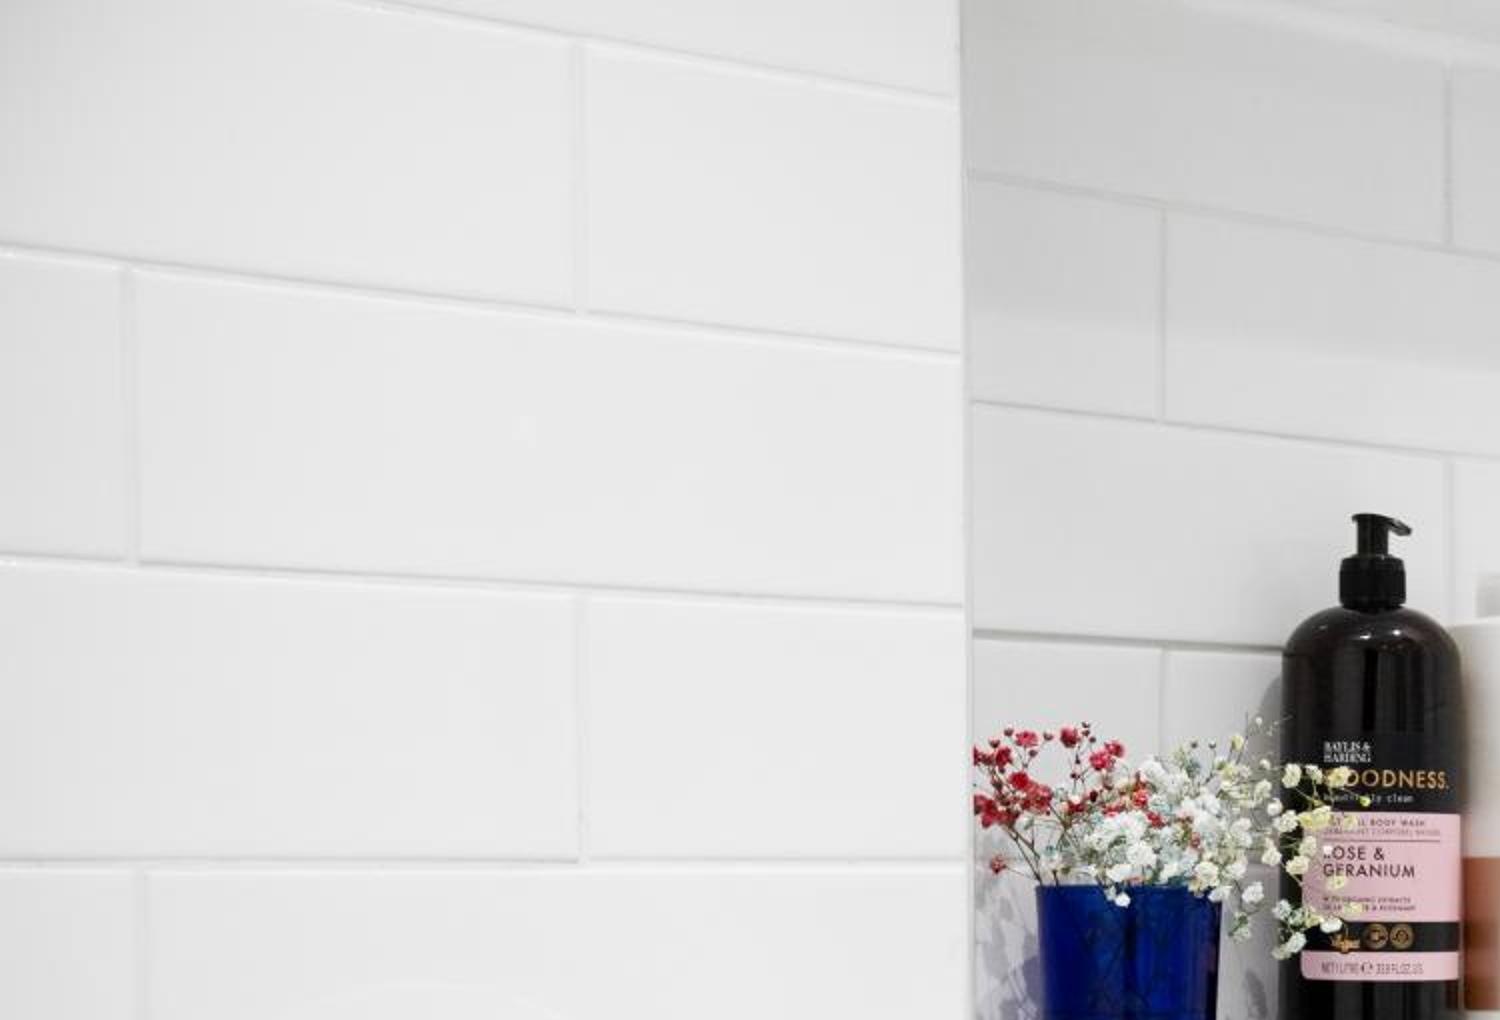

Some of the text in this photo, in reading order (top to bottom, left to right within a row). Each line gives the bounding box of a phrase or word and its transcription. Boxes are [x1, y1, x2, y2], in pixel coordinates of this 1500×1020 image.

[1323, 769, 1450, 789] OODNESS.
[1373, 847, 1385, 861] &
[1323, 863, 1416, 878] GERANIUM
